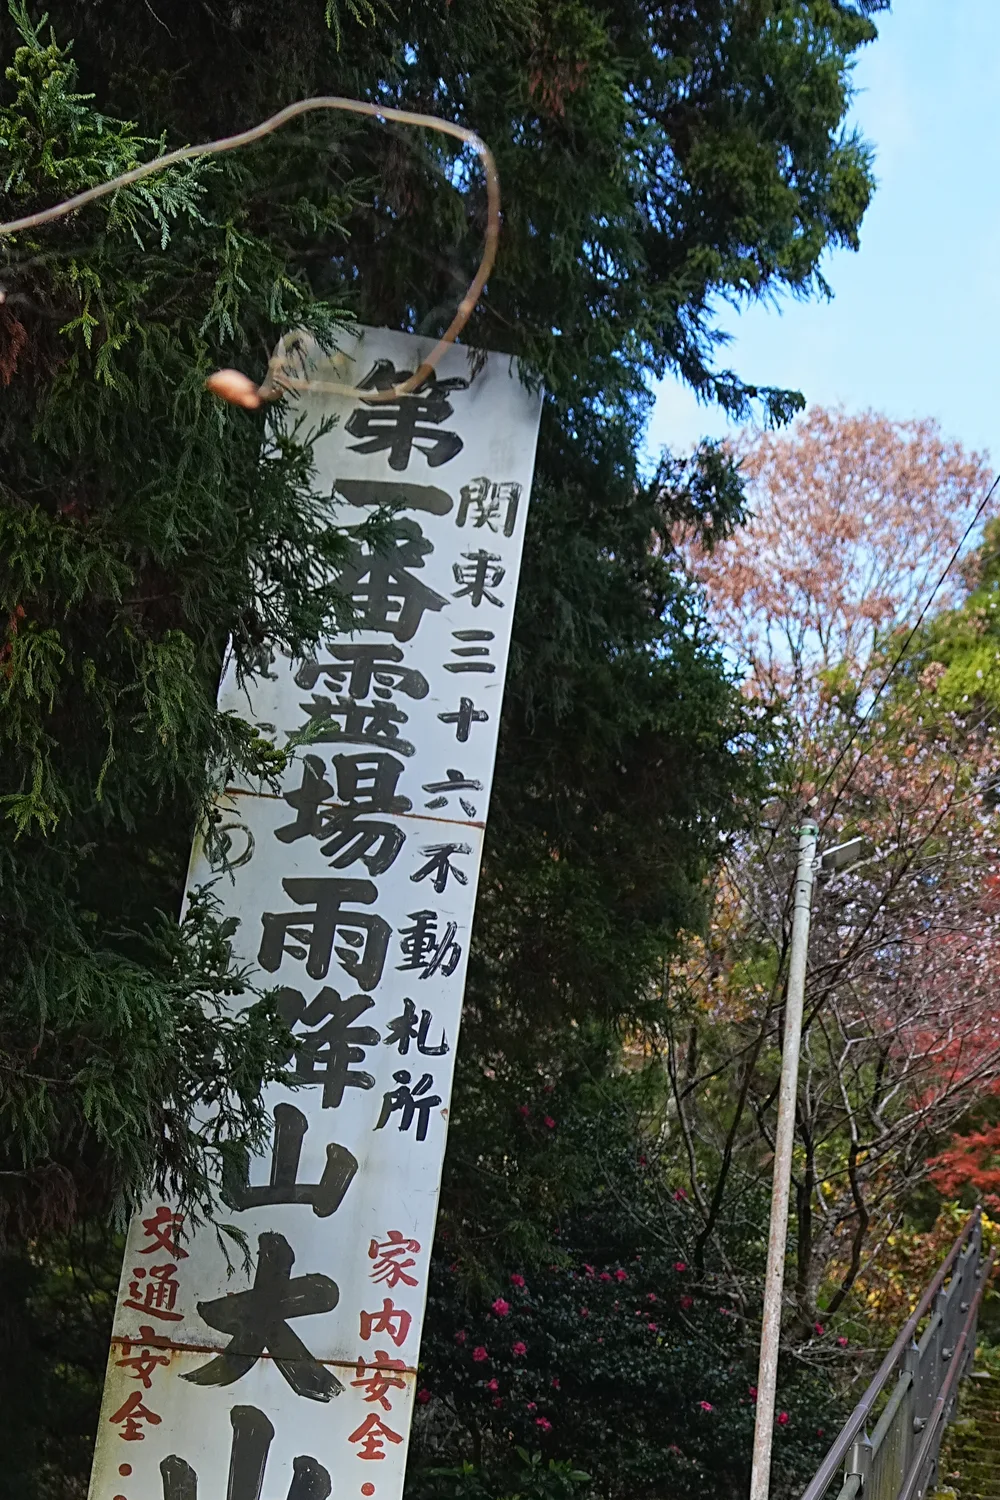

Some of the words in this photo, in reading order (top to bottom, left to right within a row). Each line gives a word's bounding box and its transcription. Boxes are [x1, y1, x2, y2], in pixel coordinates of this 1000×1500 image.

[373, 477, 523, 1141] 関東三十六不動札所
